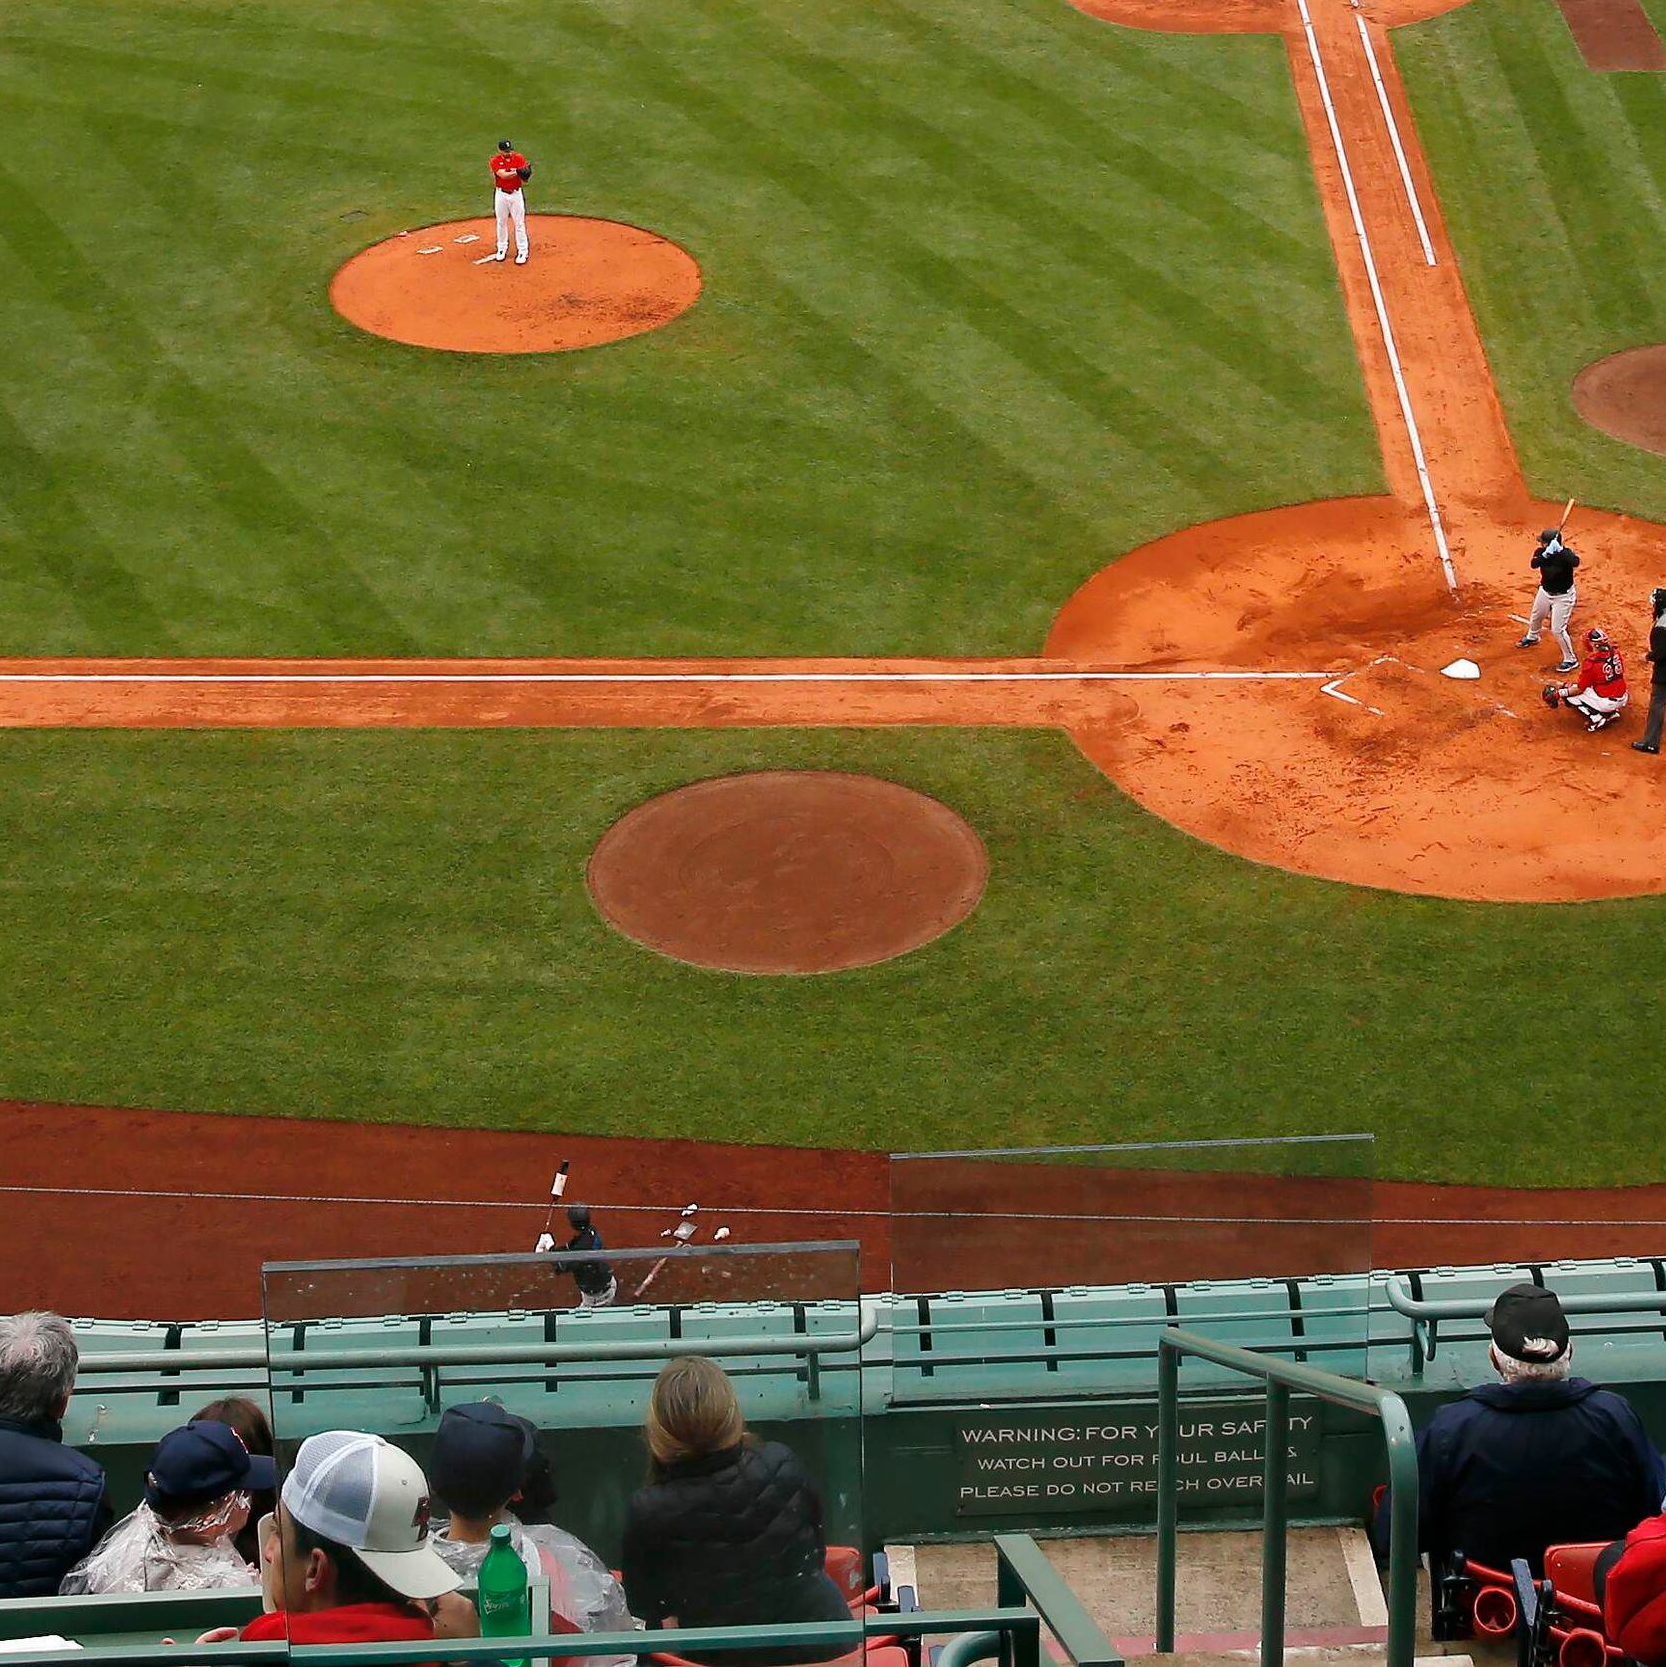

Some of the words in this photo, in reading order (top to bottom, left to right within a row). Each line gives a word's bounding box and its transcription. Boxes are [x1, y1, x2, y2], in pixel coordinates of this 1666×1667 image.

[962, 1428, 1081, 1444] WARNING:
[1086, 1426, 1138, 1441] FOR
[1144, 1422, 1215, 1439] YUR
[1221, 1416, 1314, 1436] SAFTY
[960, 1486, 1040, 1499] PLEASE
[1047, 1484, 1076, 1496] DO
[1083, 1482, 1125, 1494] NOT
[1130, 1480, 1199, 1493] RECH
[1206, 1475, 1263, 1490] OVER
[1287, 1473, 1314, 1485] AIL
